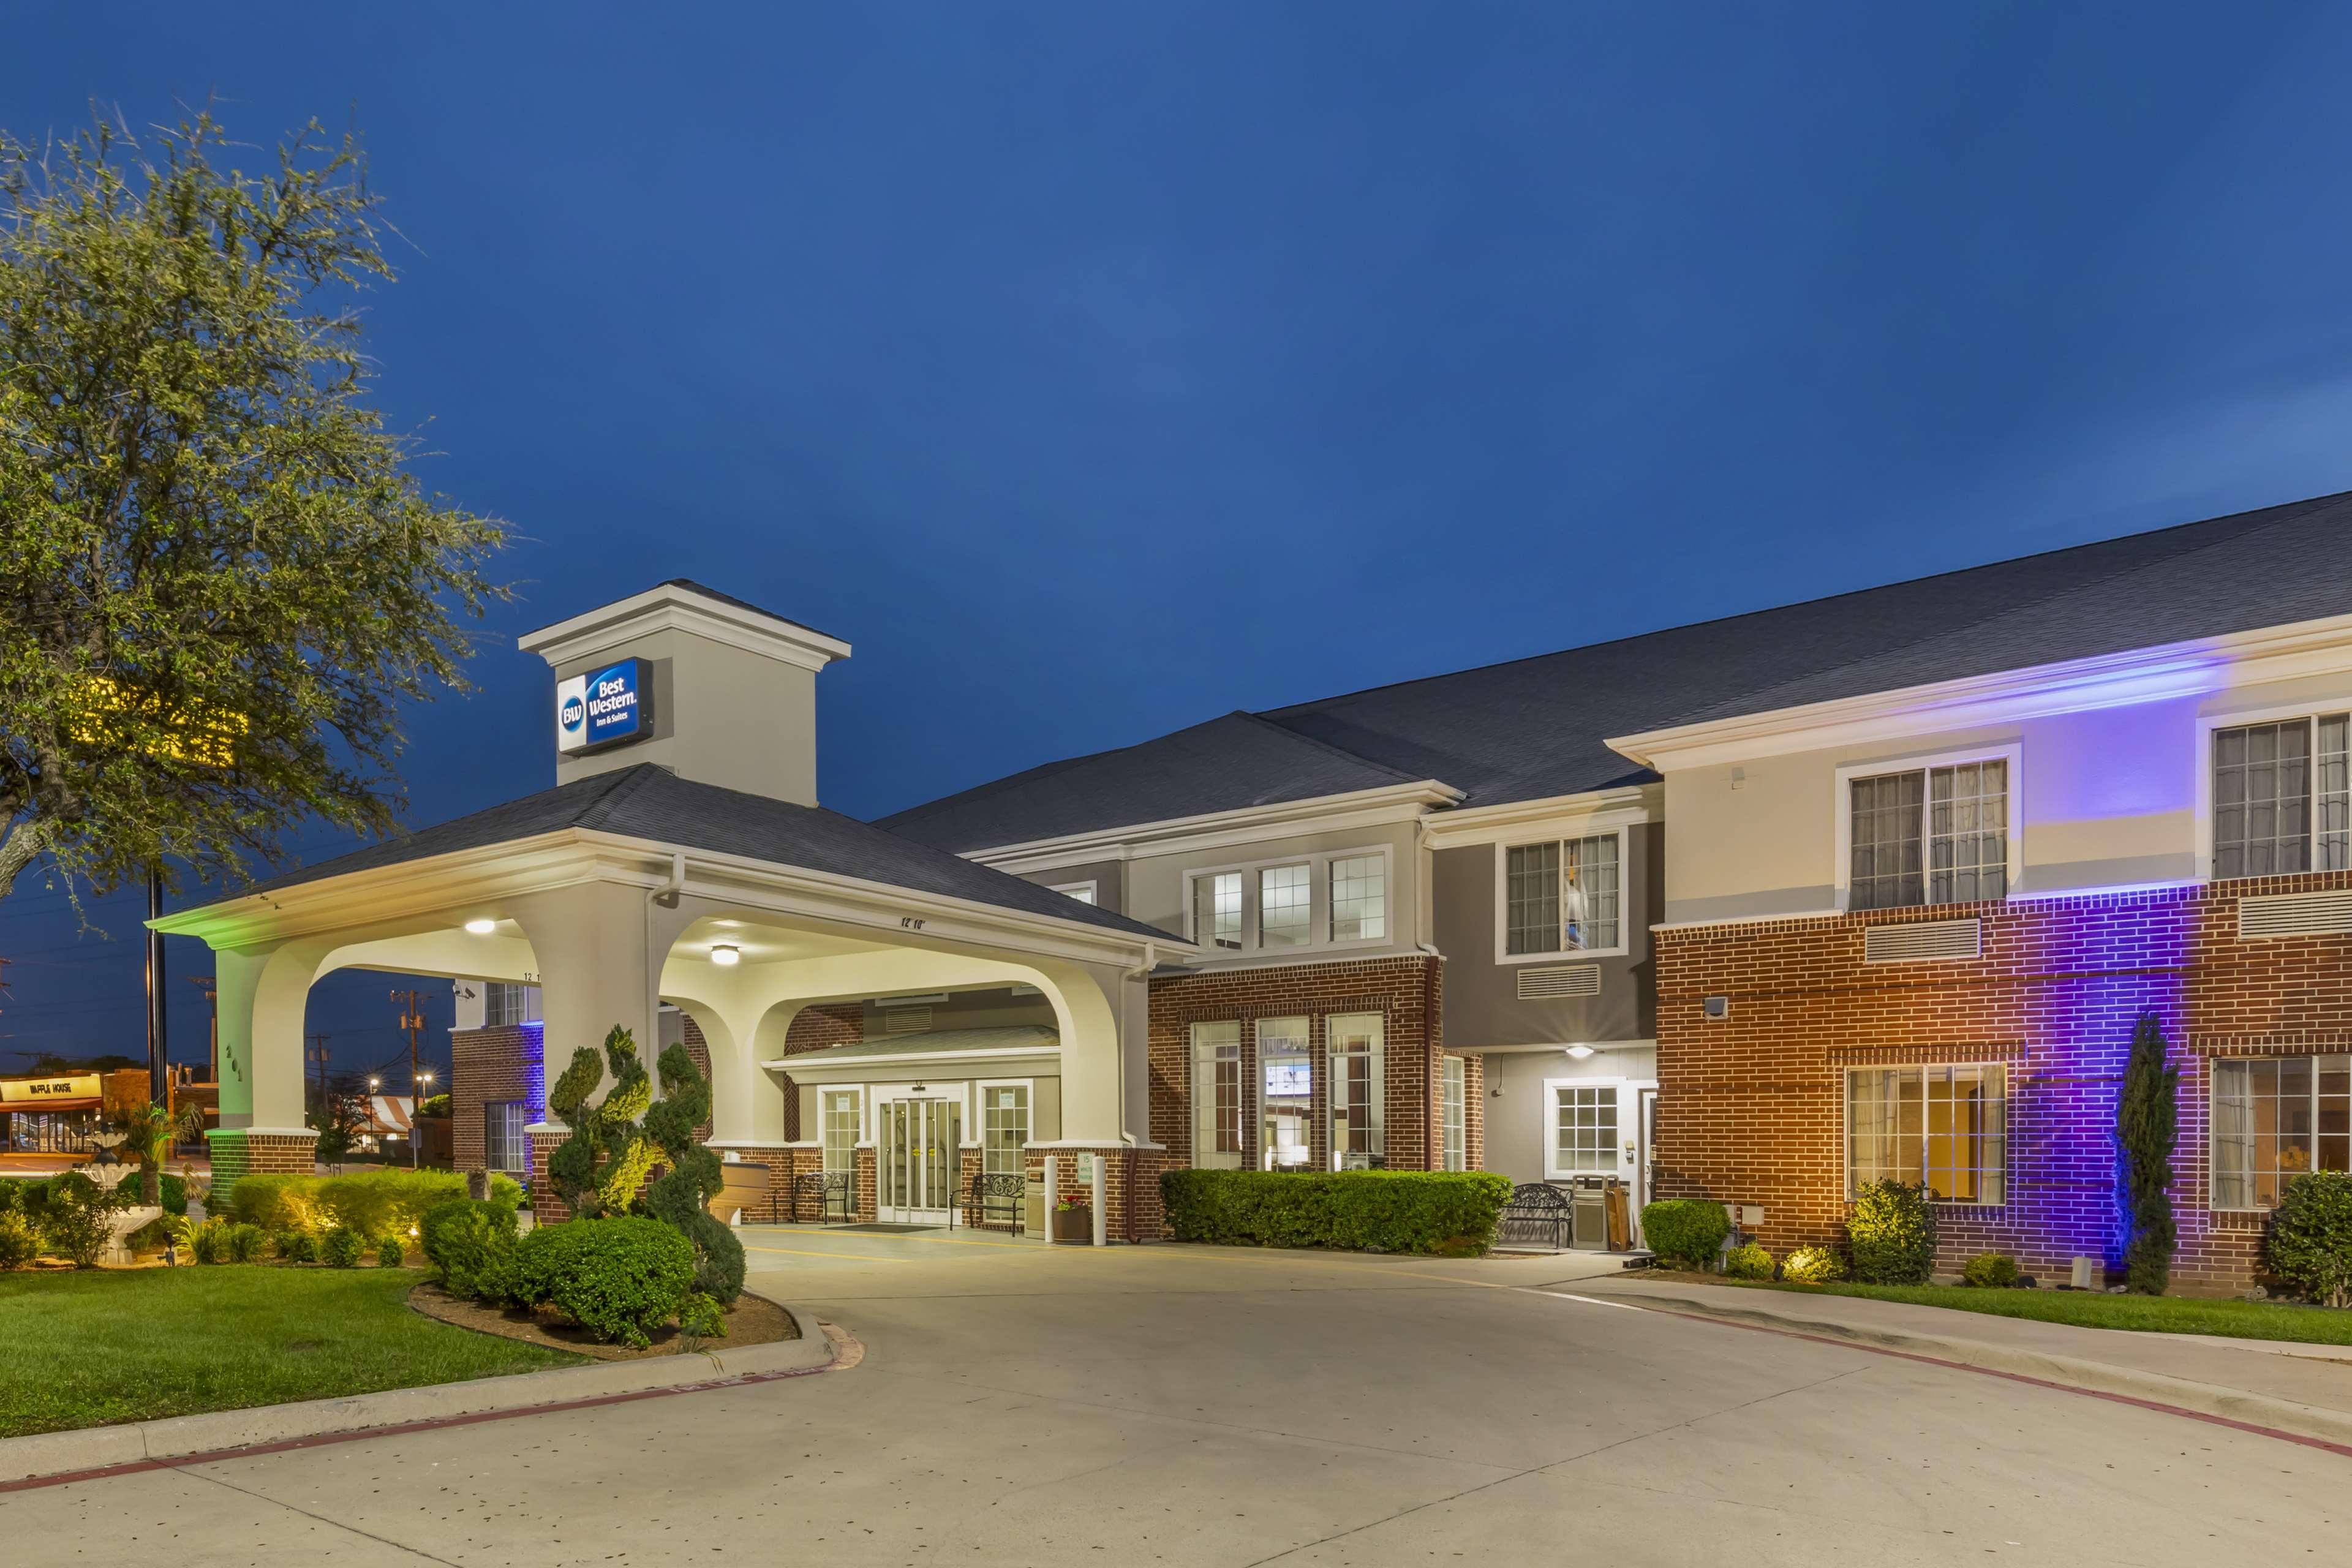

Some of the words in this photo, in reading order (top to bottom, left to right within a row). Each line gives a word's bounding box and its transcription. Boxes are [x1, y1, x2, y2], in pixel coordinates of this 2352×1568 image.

[600, 677, 625, 698] Best
[564, 705, 582, 724] BW
[606, 715, 611, 724] &
[611, 712, 628, 723] Suites
[226, 1044, 243, 1082] 201
[29, 1085, 51, 1094] WAFFLE
[53, 1083, 72, 1093] HOUSE
